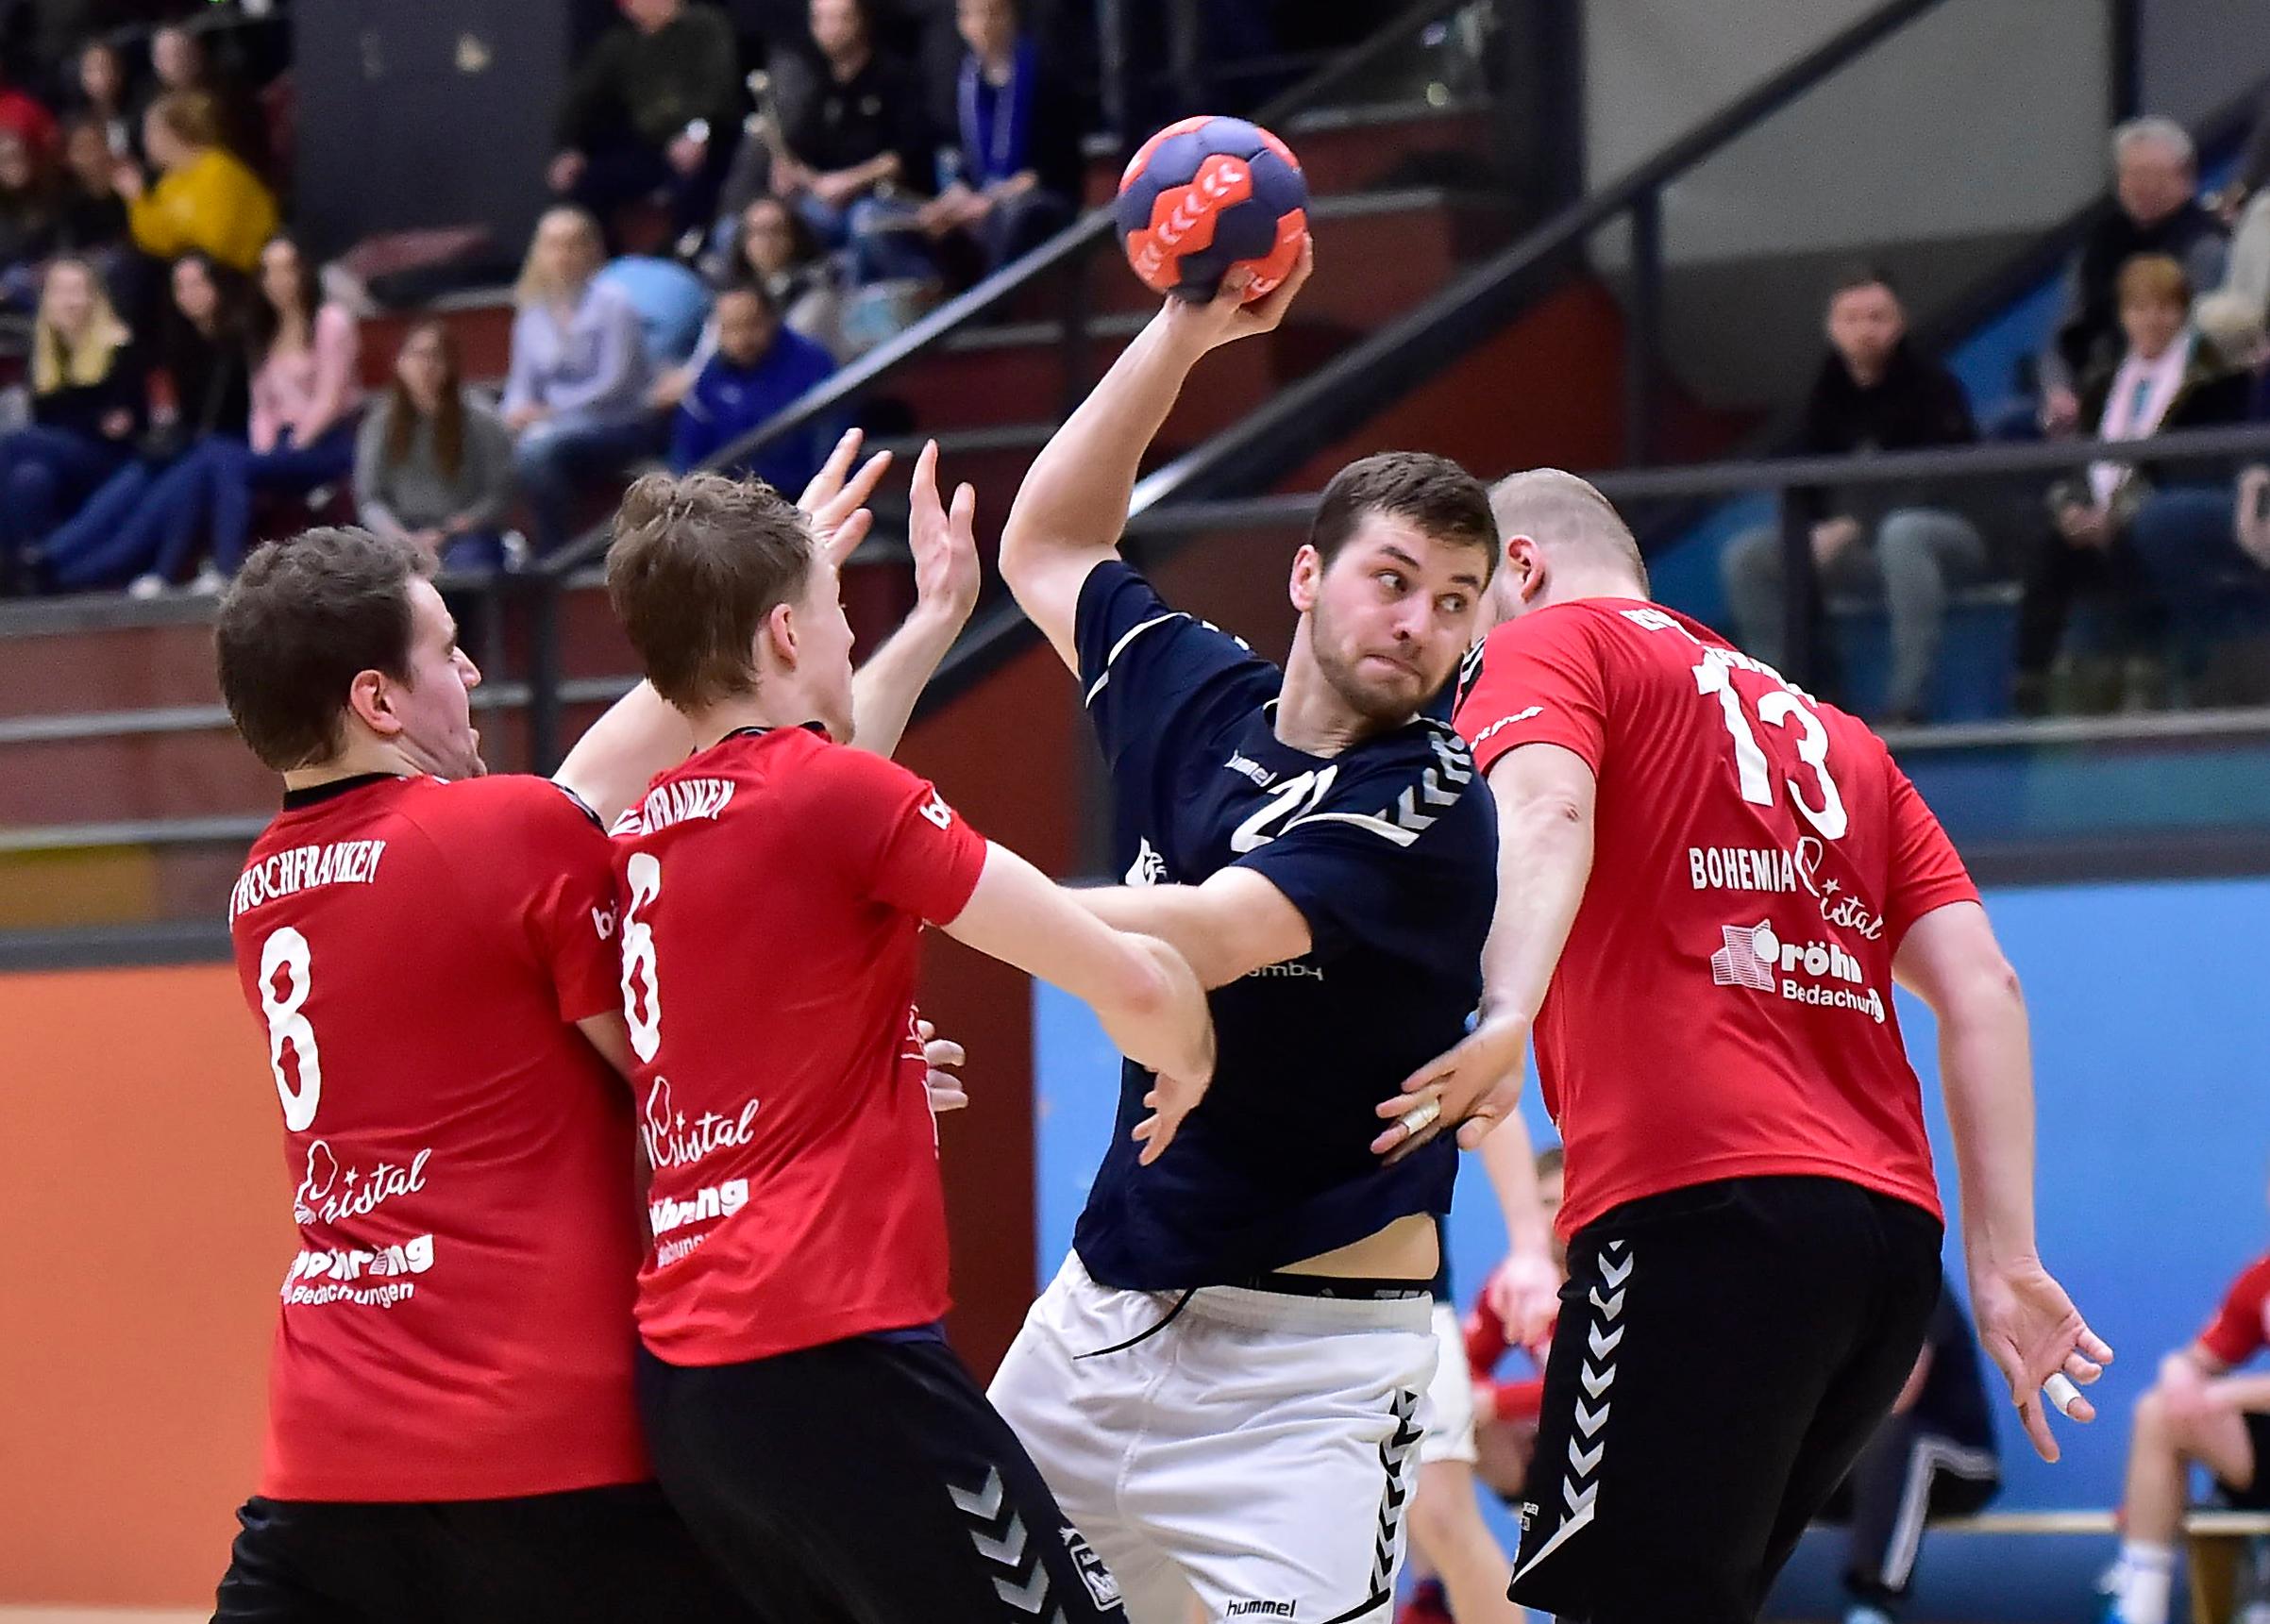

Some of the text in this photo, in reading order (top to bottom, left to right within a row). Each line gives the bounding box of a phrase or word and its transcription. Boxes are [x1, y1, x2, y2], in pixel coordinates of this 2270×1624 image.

[1691, 651, 1847, 840] 13
[621, 851, 661, 1064] 6
[1690, 846, 1797, 893] BOHEMIA
[258, 926, 322, 1132] 8
[1226, 1599, 1297, 1618] hummel
